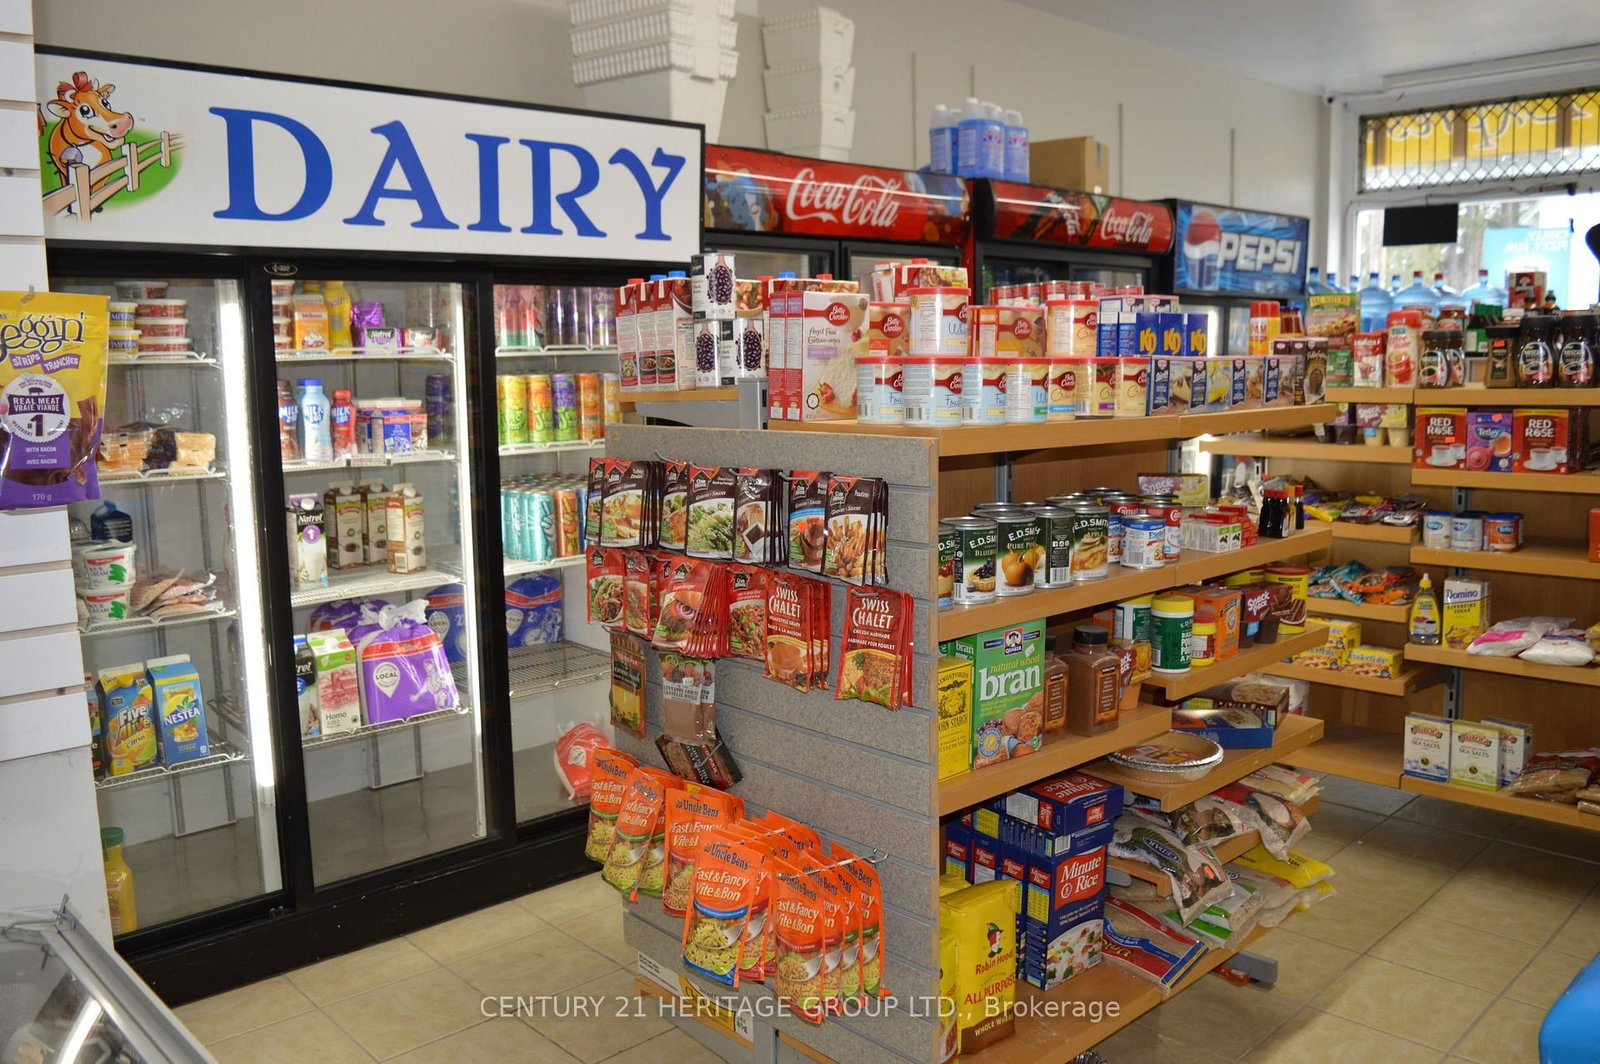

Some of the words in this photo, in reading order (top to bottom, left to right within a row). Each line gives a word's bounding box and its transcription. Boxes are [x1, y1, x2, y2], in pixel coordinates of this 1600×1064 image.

[209, 106, 686, 241] DAIRY
[1217, 231, 1301, 275] PEPSI
[0, 312, 84, 354] eggin'
[13, 397, 35, 405] REAL
[38, 397, 60, 405] MEAT
[14, 404, 35, 412] VRAIE
[36, 404, 60, 412] VIANDE
[1430, 417, 1452, 427] RED
[1529, 419, 1552, 429] RED
[1426, 425, 1454, 436] ROSE
[1477, 427, 1500, 437] Tetley
[1525, 427, 1554, 438] ROSE
[969, 535, 998, 549] E.D.SM
[776, 586, 798, 602] SWISS
[1446, 588, 1478, 600] Domino
[769, 595, 801, 618] CHALET
[862, 597, 890, 613] SWISS
[852, 607, 894, 630] CHALET
[955, 640, 974, 654] bran
[1005, 645, 1022, 654] QUAKER
[990, 659, 1019, 674] natural
[375, 671, 398, 680] LOCAL
[979, 664, 1042, 701] bran
[119, 706, 148, 725] Five
[163, 708, 200, 727] NESTEA
[325, 712, 347, 721] Homo
[115, 717, 151, 747] Alive
[608, 780, 627, 793] Fancy
[1044, 777, 1075, 793] Rice
[1056, 778, 1103, 798] Minute
[608, 792, 622, 804] Bon
[683, 800, 702, 813] Uncle
[701, 803, 720, 818] Ben's
[671, 821, 689, 834] Fast
[673, 835, 690, 848] Vite
[711, 843, 732, 863] Uncle
[730, 852, 749, 871] Ben's
[1060, 856, 1102, 884] Minute
[720, 870, 750, 889] Fancy
[1075, 874, 1099, 894] Rice
[720, 886, 741, 902] Bon
[795, 900, 820, 923] Fancy
[799, 918, 815, 935] Bon
[975, 960, 996, 975] Robin
[996, 949, 1014, 963] Hood
[964, 991, 982, 1005] ALL
[975, 1021, 995, 1037] WHOLE
